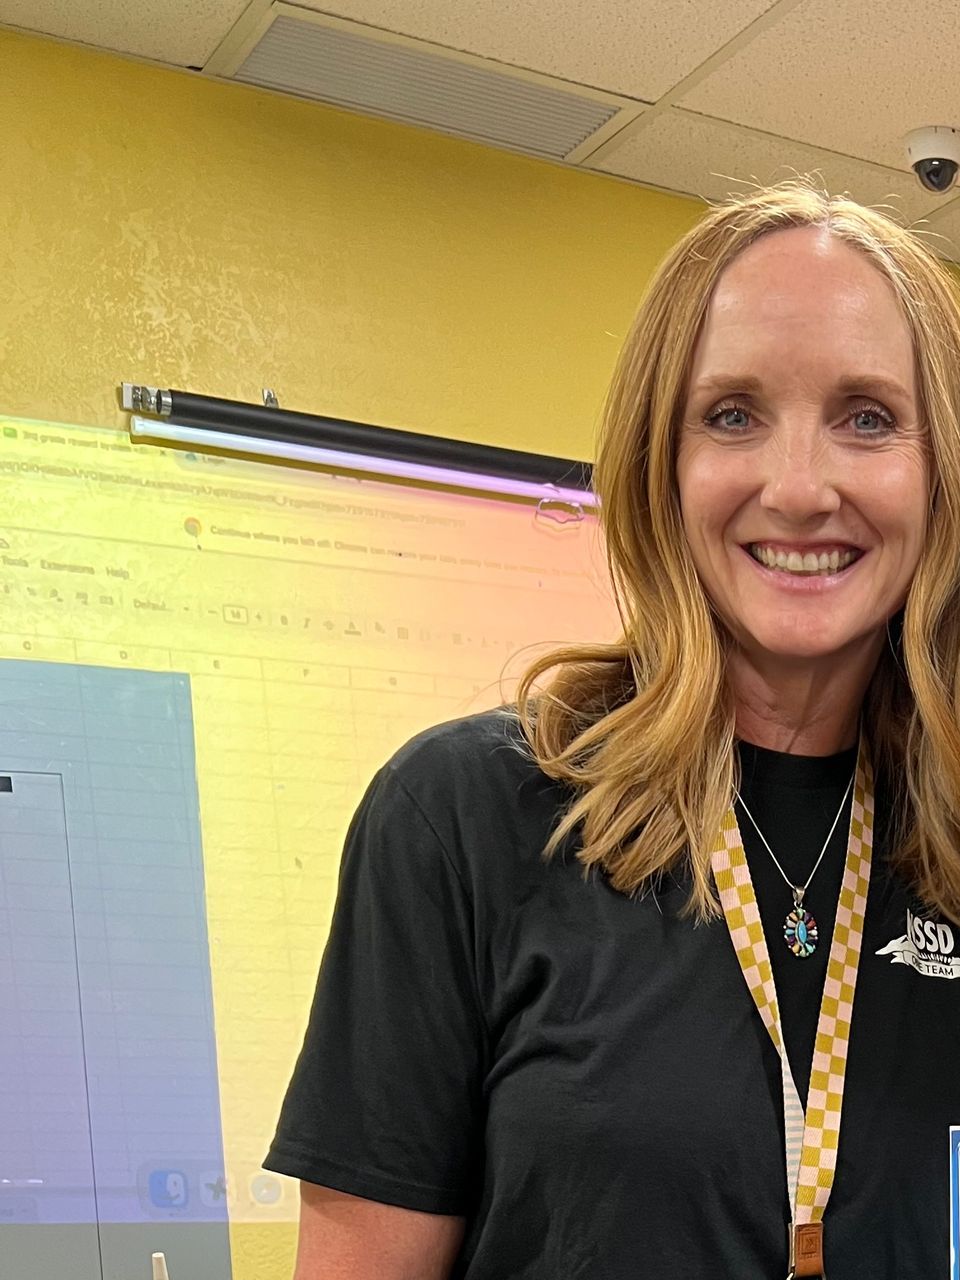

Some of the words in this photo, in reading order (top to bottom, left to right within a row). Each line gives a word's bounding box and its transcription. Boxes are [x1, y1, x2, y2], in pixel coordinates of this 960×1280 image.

[40, 560, 95, 575] Extensions
[106, 567, 129, 579] Help
[925, 965, 954, 976] TEAM
